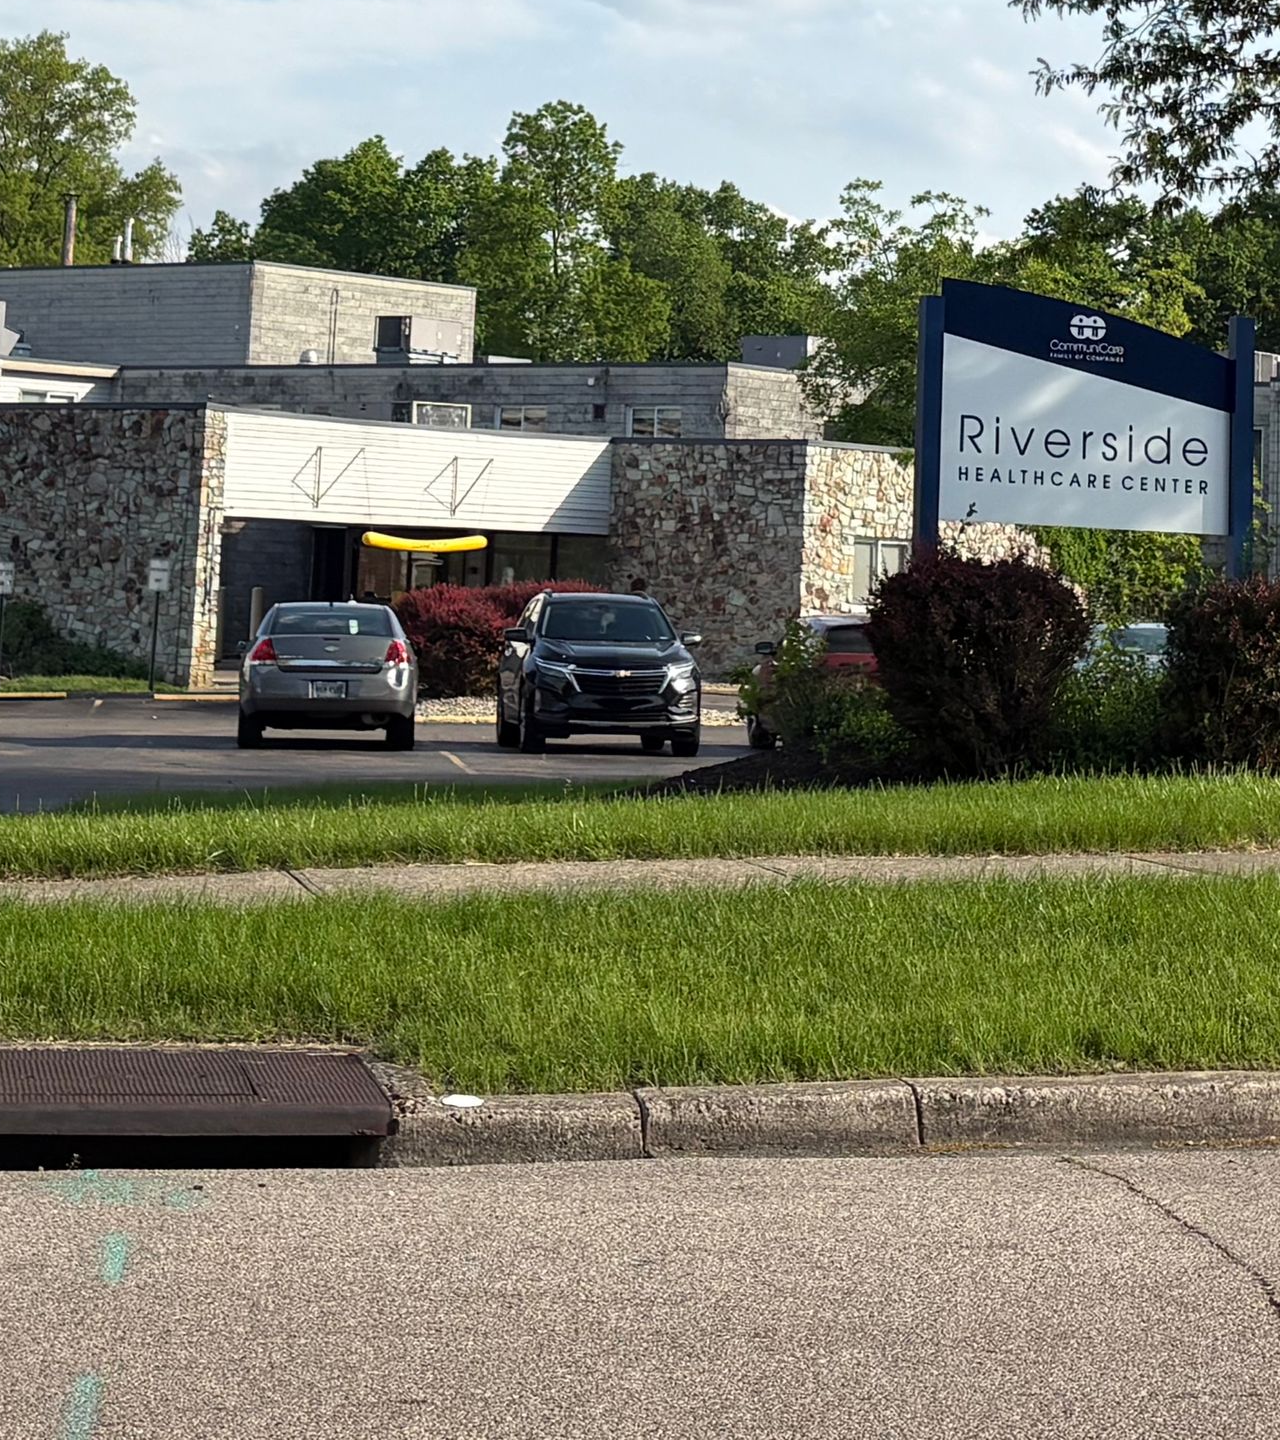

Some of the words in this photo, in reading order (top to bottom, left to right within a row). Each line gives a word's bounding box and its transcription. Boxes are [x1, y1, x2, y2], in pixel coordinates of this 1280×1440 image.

[959, 414, 1209, 467] Riverside
[958, 466, 1111, 490] HEALTHCARE
[1121, 475, 1209, 495] CENTER
